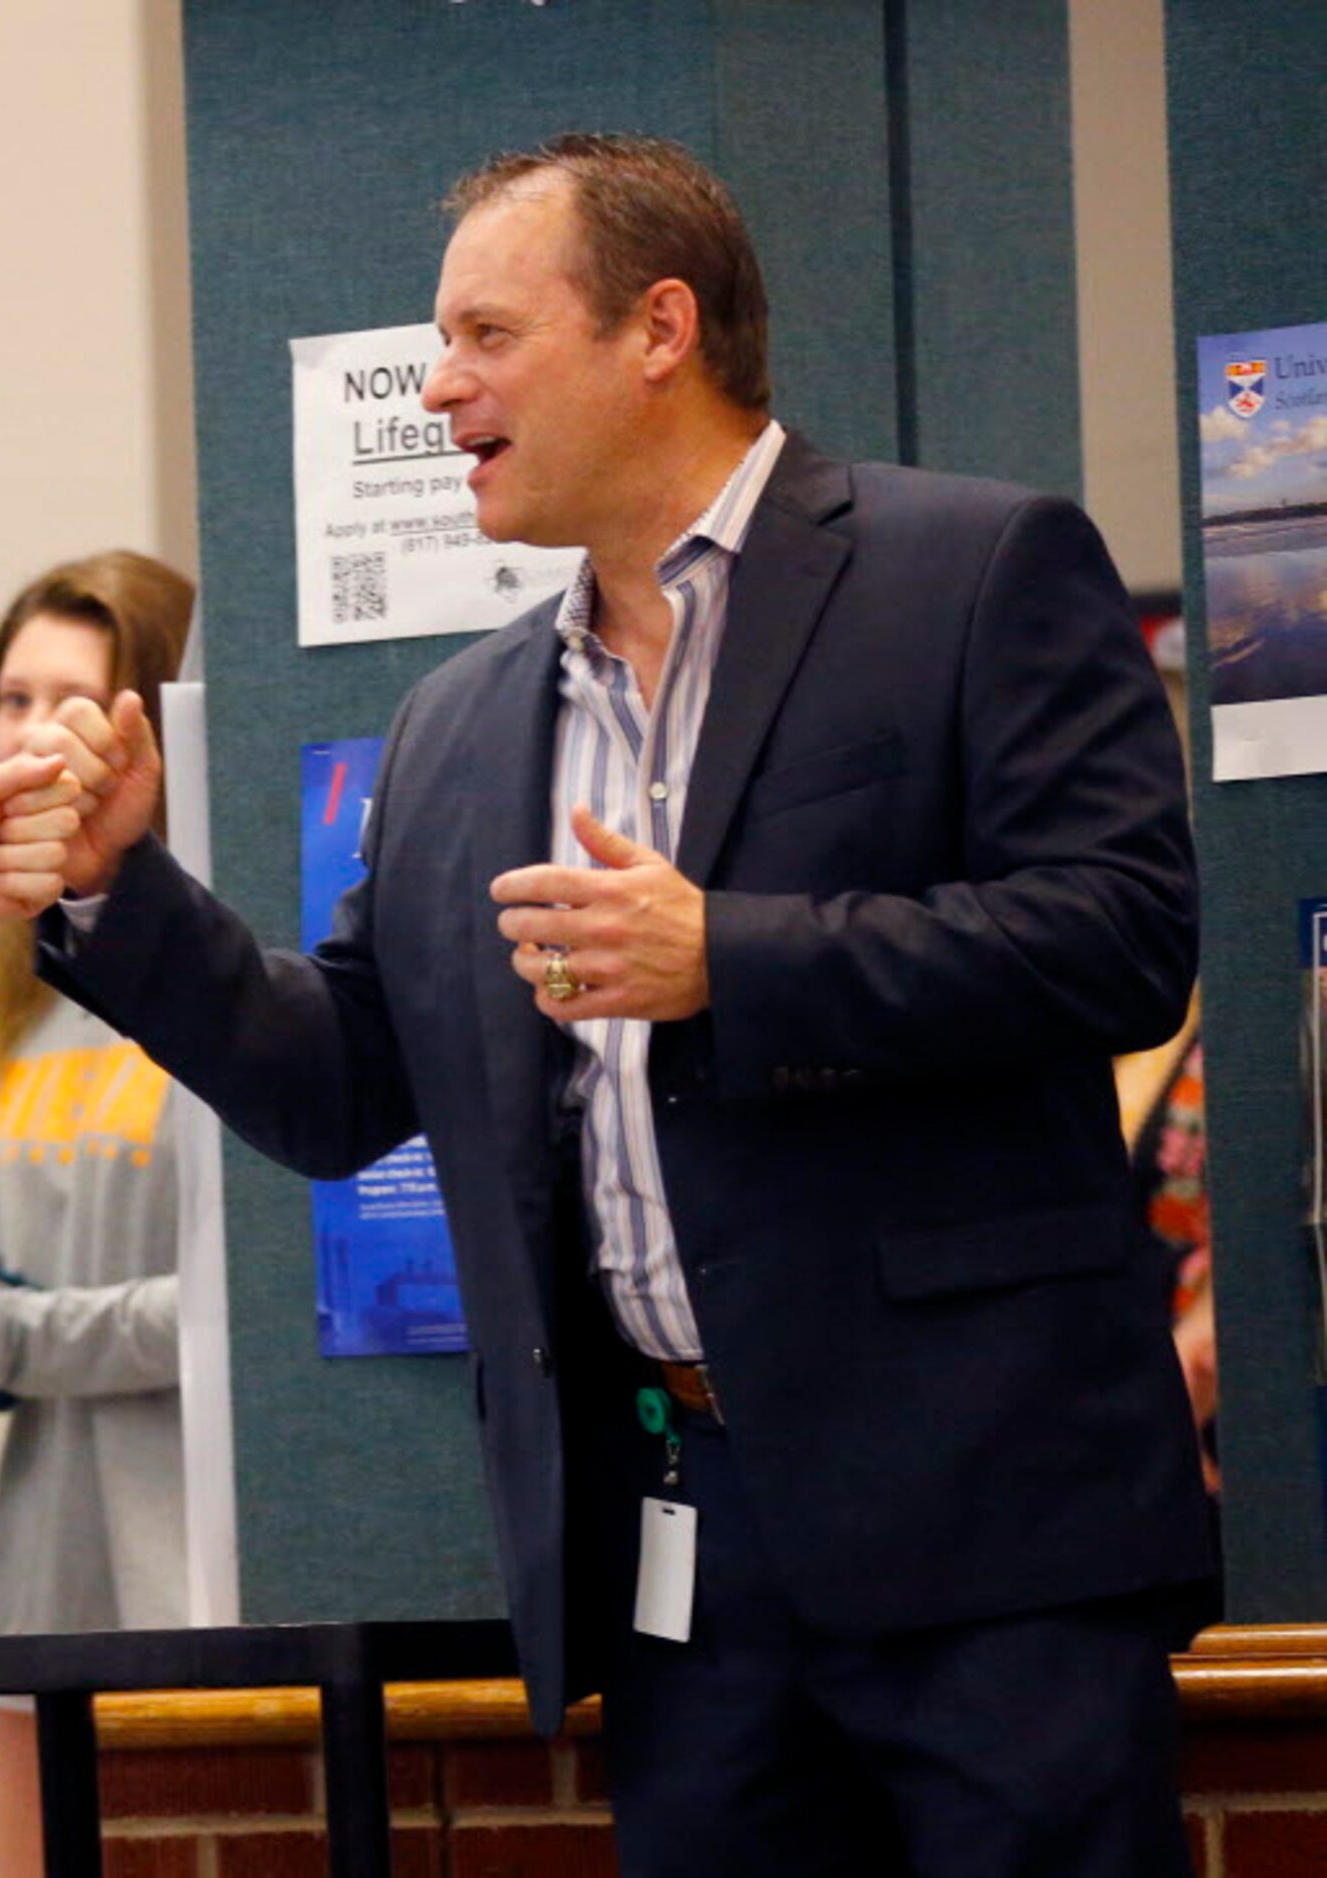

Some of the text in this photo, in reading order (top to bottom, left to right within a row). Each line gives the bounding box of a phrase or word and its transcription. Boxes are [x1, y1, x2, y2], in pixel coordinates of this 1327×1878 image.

[344, 362, 427, 402] NOW
[354, 416, 444, 456] Lifeg
[353, 475, 461, 499] Starting pay
